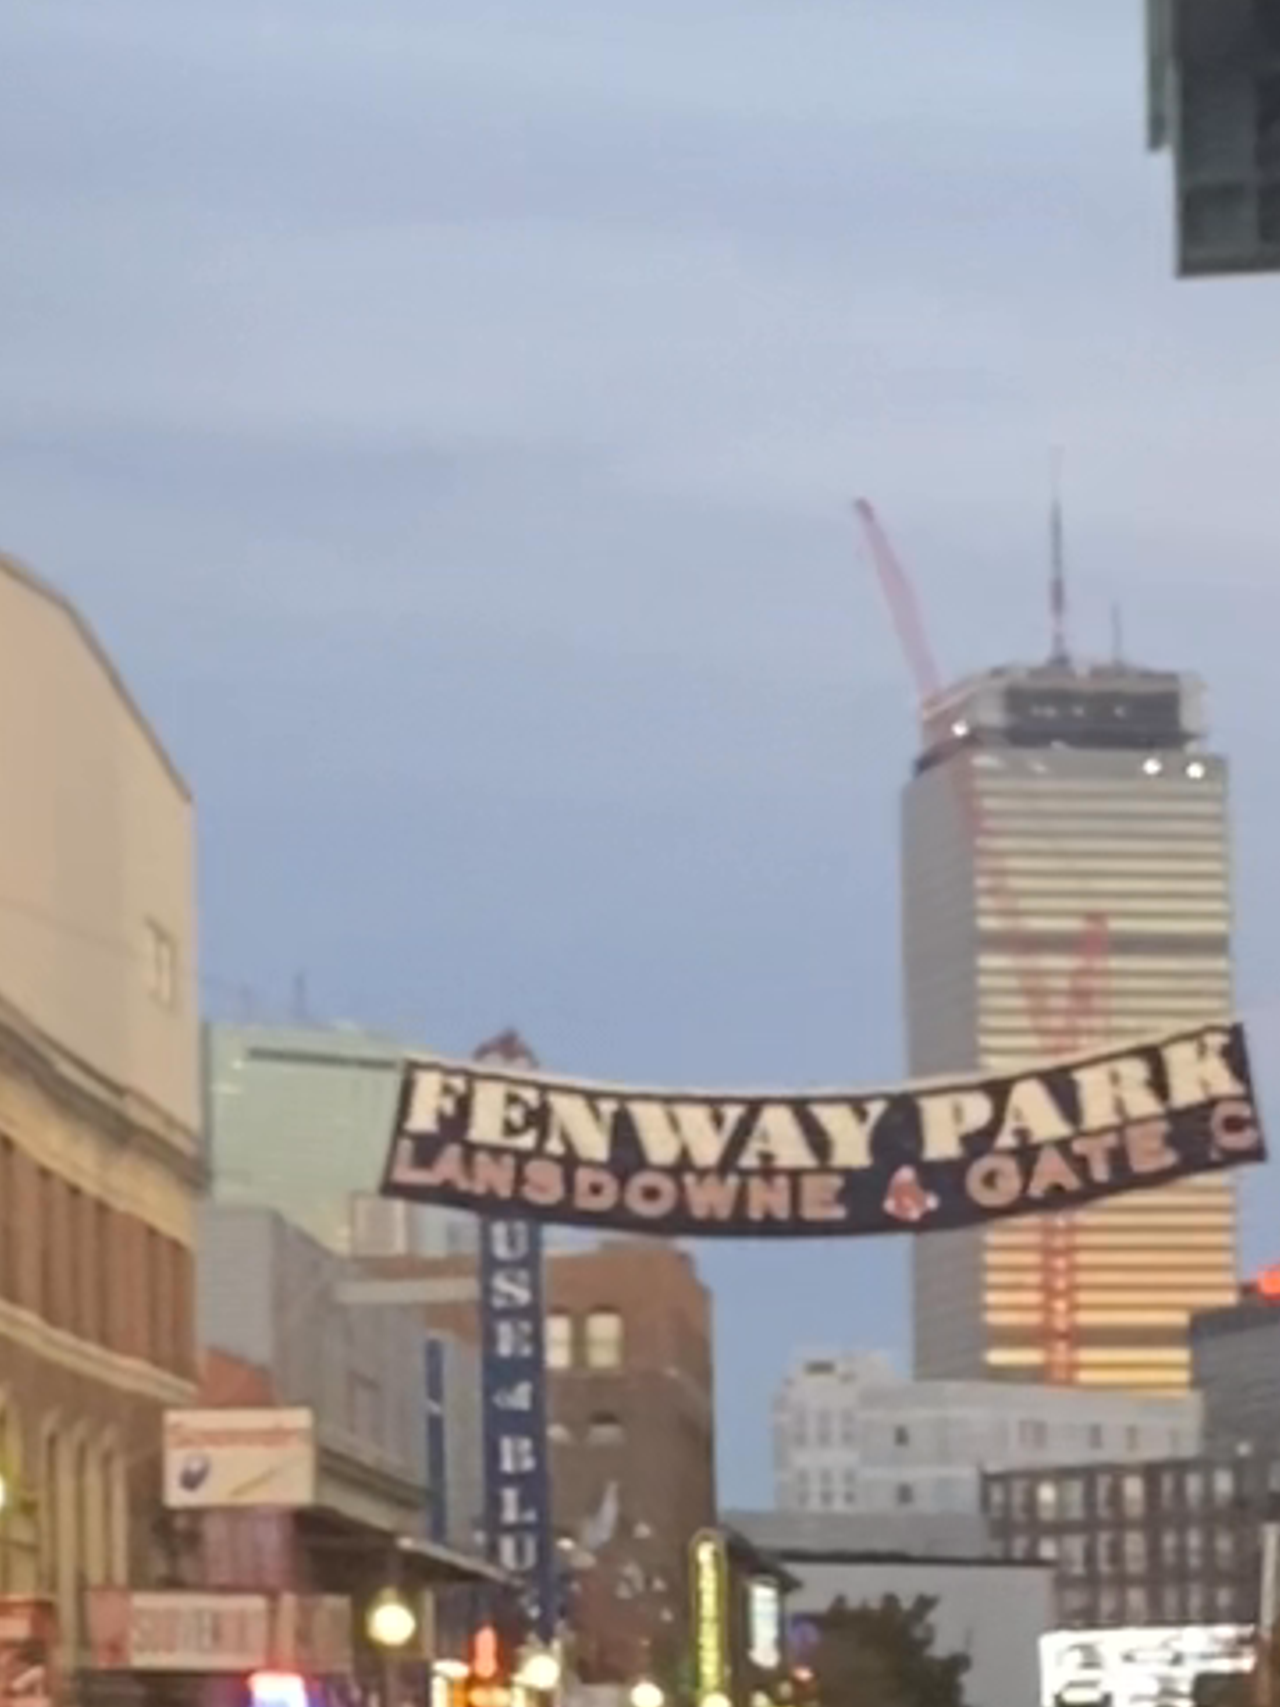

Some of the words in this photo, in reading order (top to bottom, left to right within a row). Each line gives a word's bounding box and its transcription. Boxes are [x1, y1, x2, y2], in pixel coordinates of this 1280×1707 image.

[404, 1070, 888, 1170] FENWAY
[915, 1032, 1248, 1161] PARK
[391, 1138, 847, 1221] LANSDOWNE
[965, 1121, 1179, 1209] GATE
[490, 1221, 533, 1357] USE
